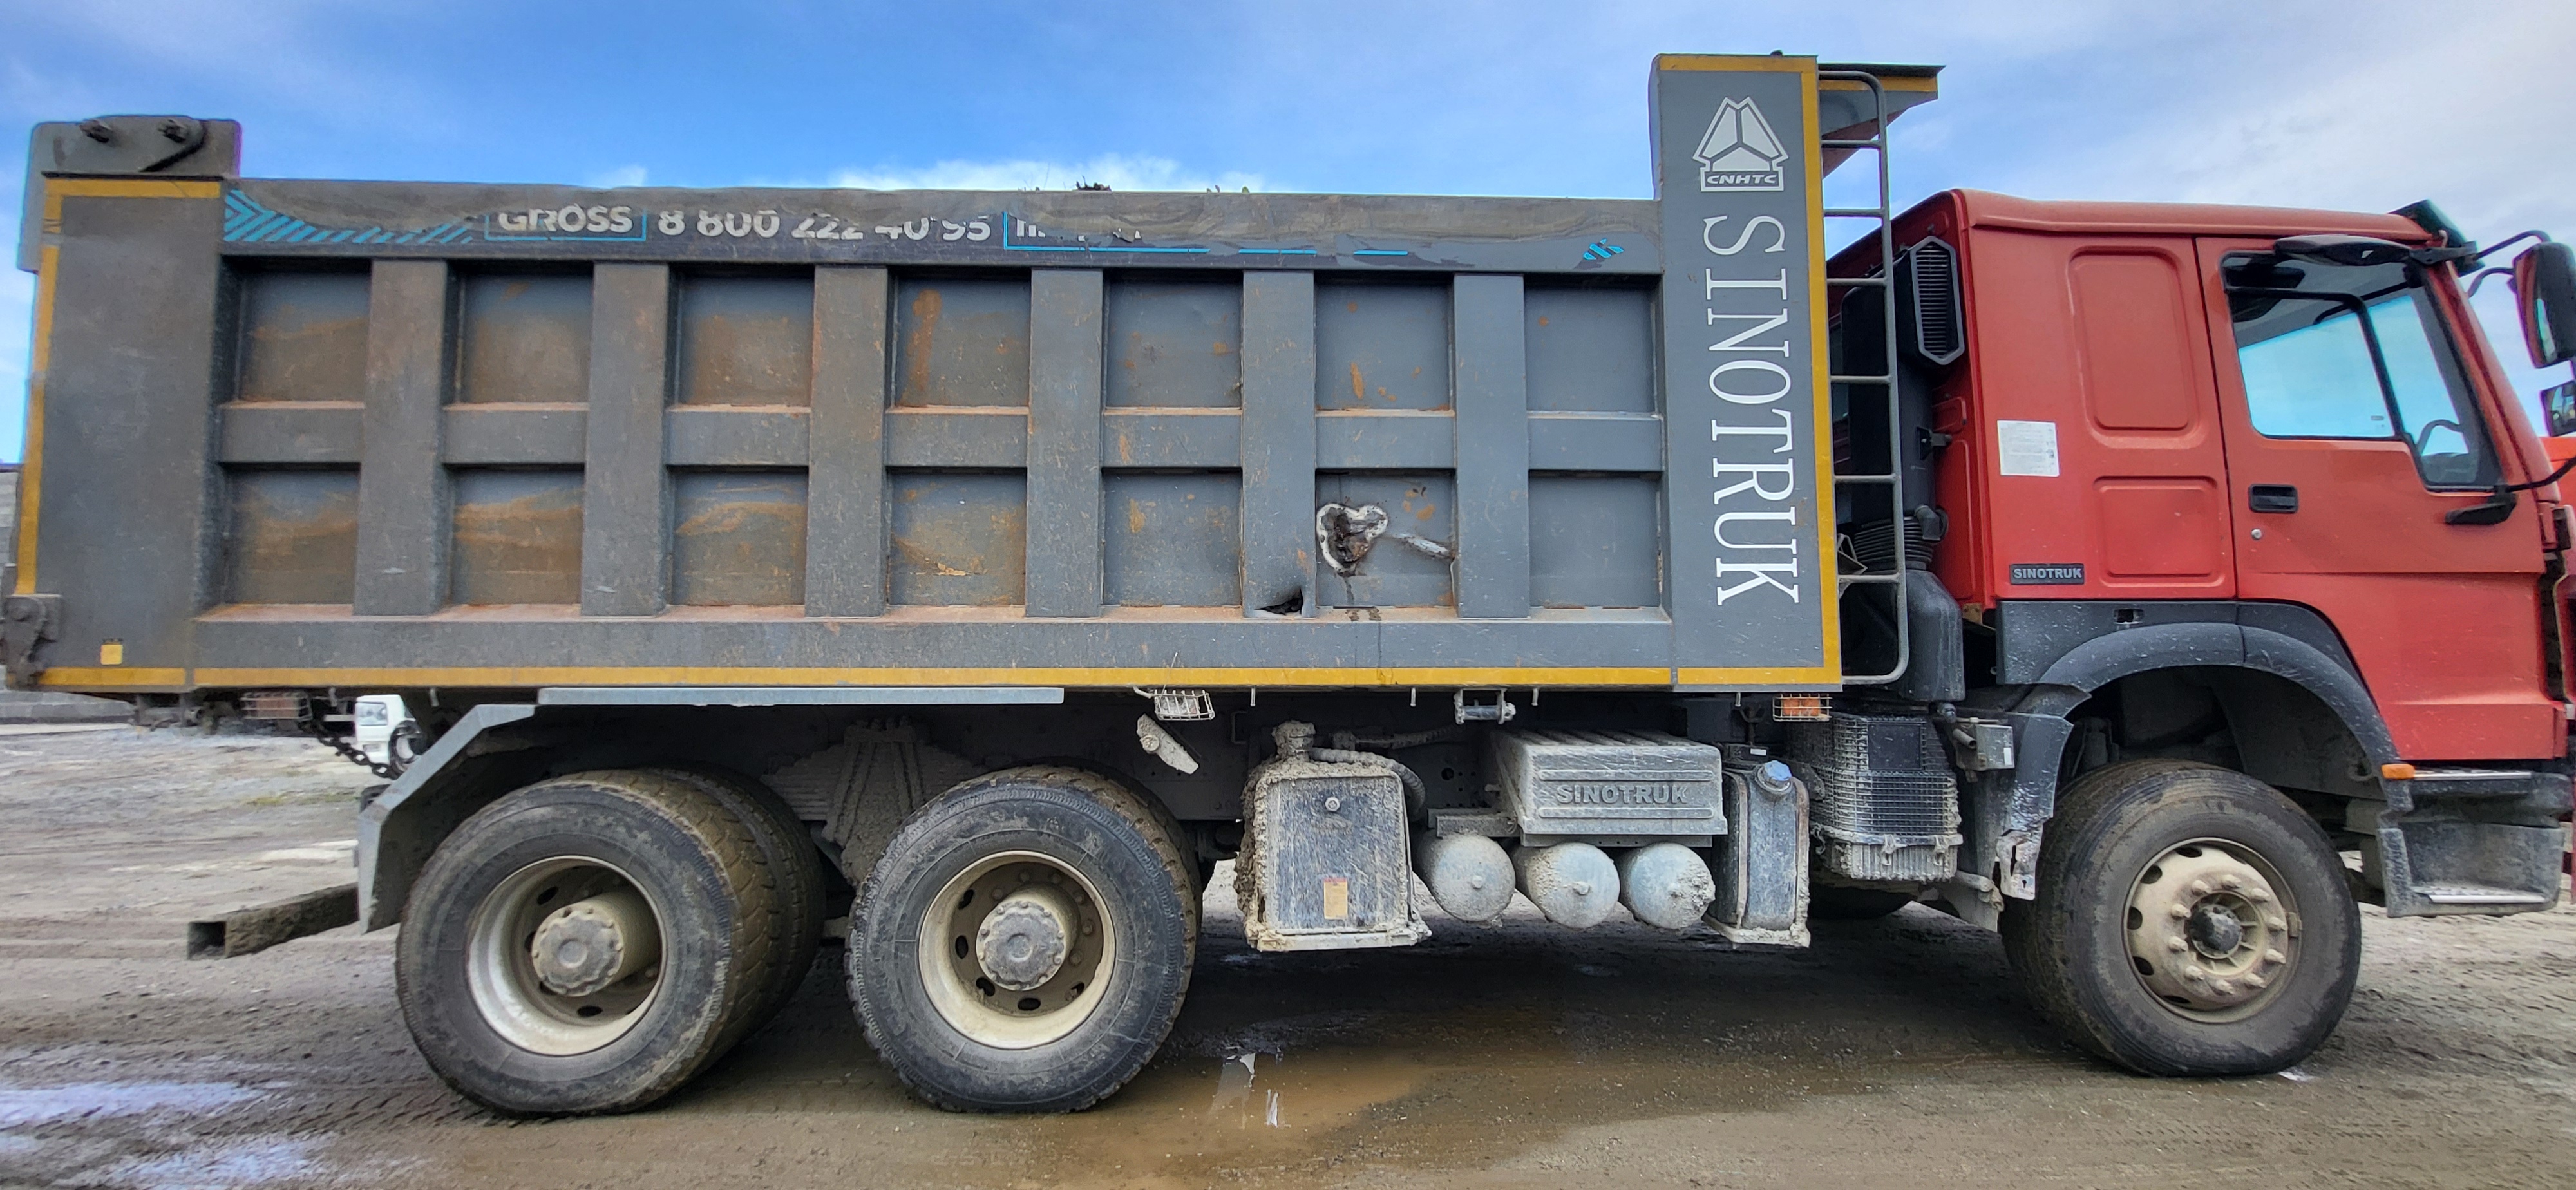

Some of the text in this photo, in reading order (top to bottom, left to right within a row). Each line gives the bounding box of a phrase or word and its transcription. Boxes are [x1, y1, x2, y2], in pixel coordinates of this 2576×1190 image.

[1706, 175, 1777, 184] CNHTC
[498, 203, 633, 232] GROSS
[658, 210, 685, 236] 8
[697, 209, 780, 238] 800
[1703, 215, 1799, 606] SINOTRUK
[2013, 568, 2082, 579] SINOTRUK
[1556, 784, 1689, 804] SINOTRUK
